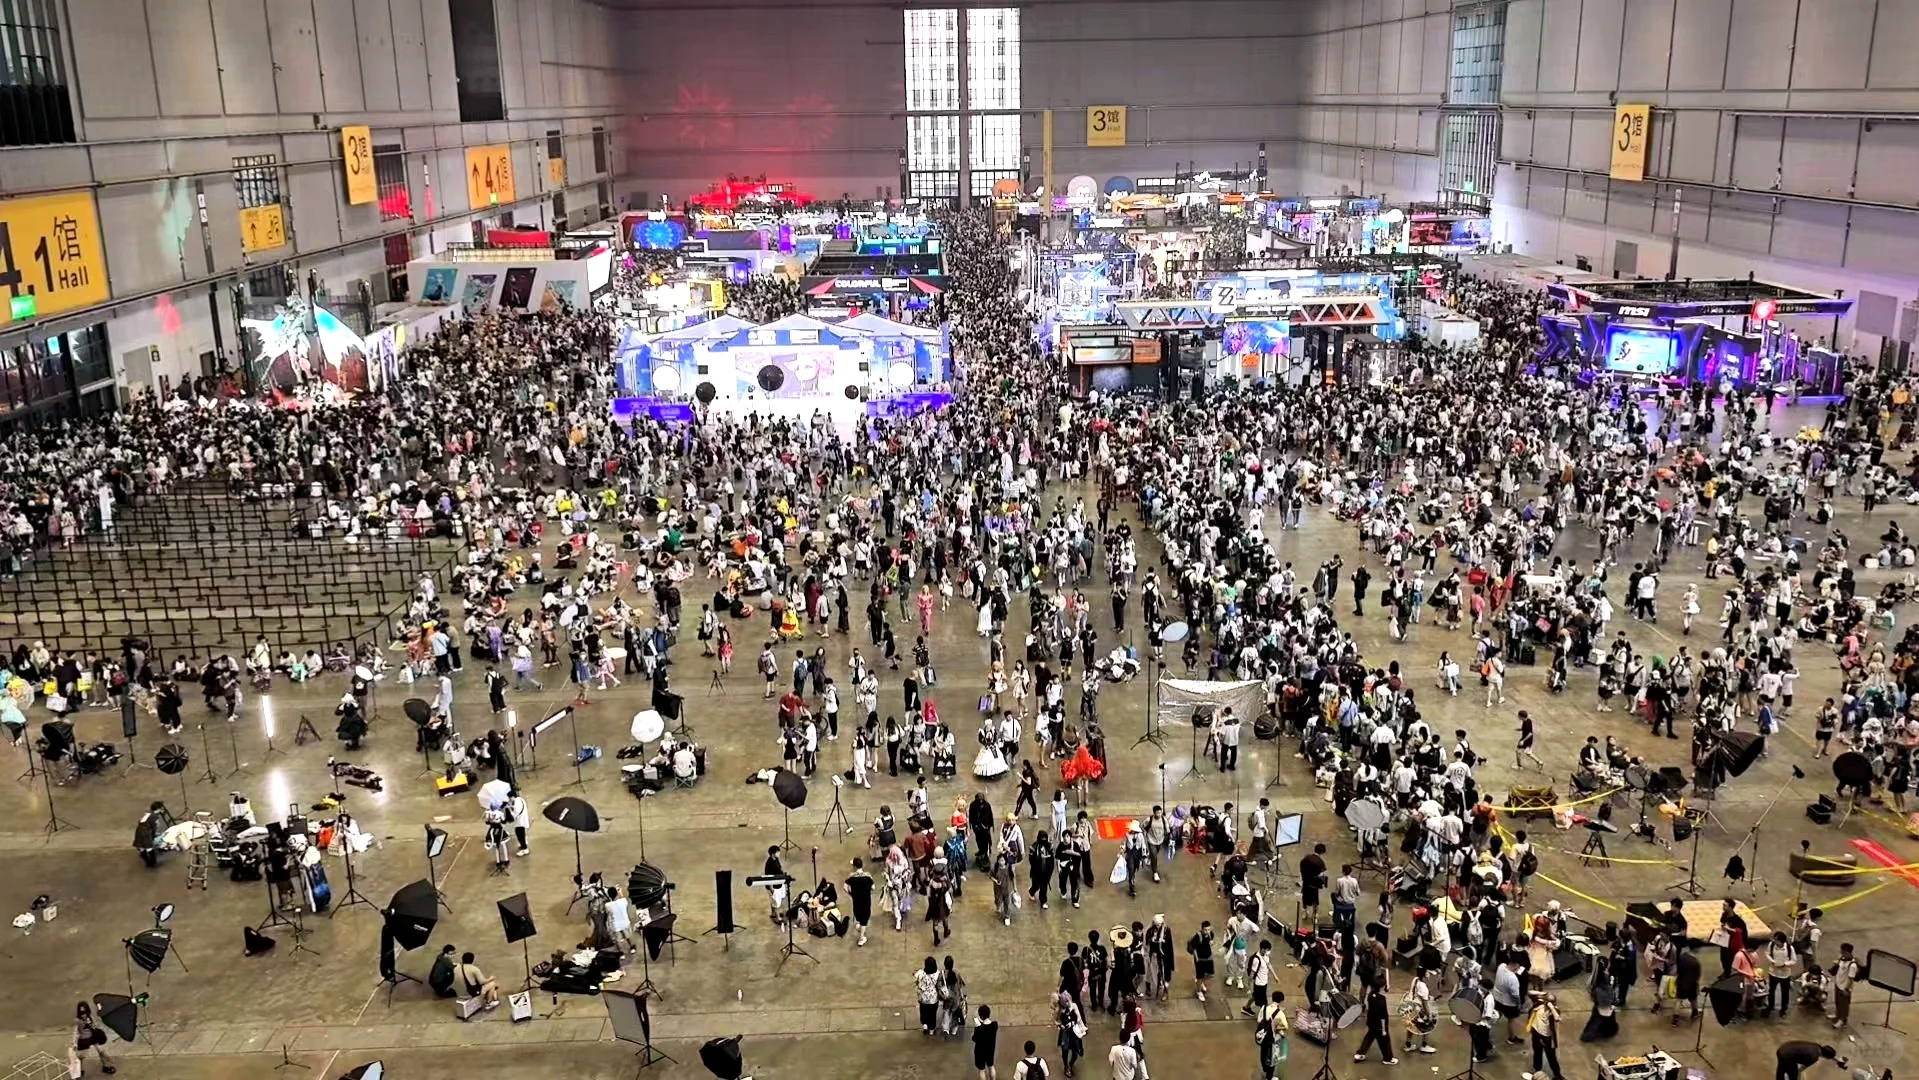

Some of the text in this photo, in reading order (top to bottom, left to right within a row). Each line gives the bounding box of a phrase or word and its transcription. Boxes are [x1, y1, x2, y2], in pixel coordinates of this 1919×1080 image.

[1093, 110, 1106, 131] 3
[1619, 113, 1631, 151] 3
[348, 135, 361, 175] 3
[53, 215, 81, 262] 馆
[58, 265, 89, 289] Hall
